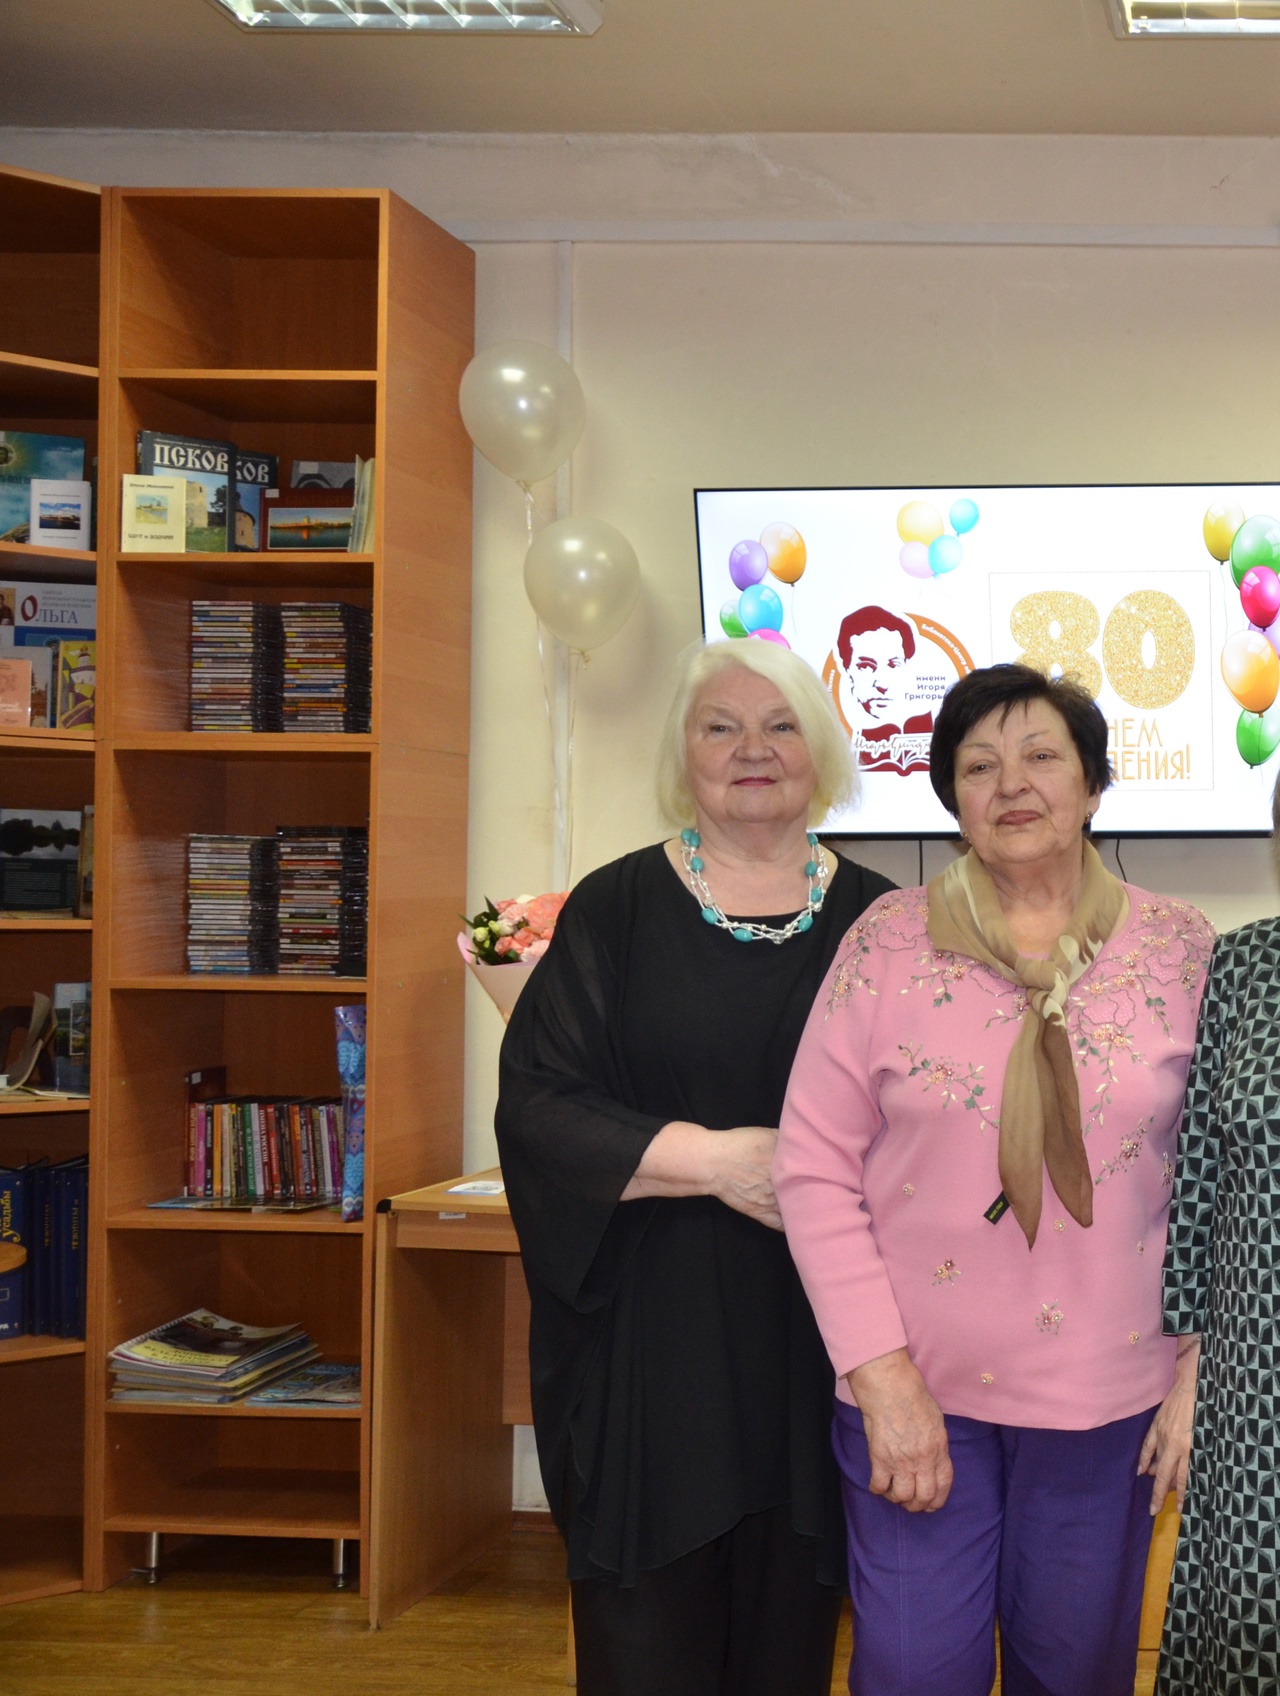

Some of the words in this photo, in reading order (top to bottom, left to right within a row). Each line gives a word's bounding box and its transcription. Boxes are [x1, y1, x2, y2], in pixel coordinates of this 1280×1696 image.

[153, 443, 229, 472] ПСКОВ
[21, 595, 78, 624] ОЛЬГА
[1010, 590, 1196, 710] 80
[904, 693, 945, 701] Григорь
[1106, 718, 1163, 748] НЕМ
